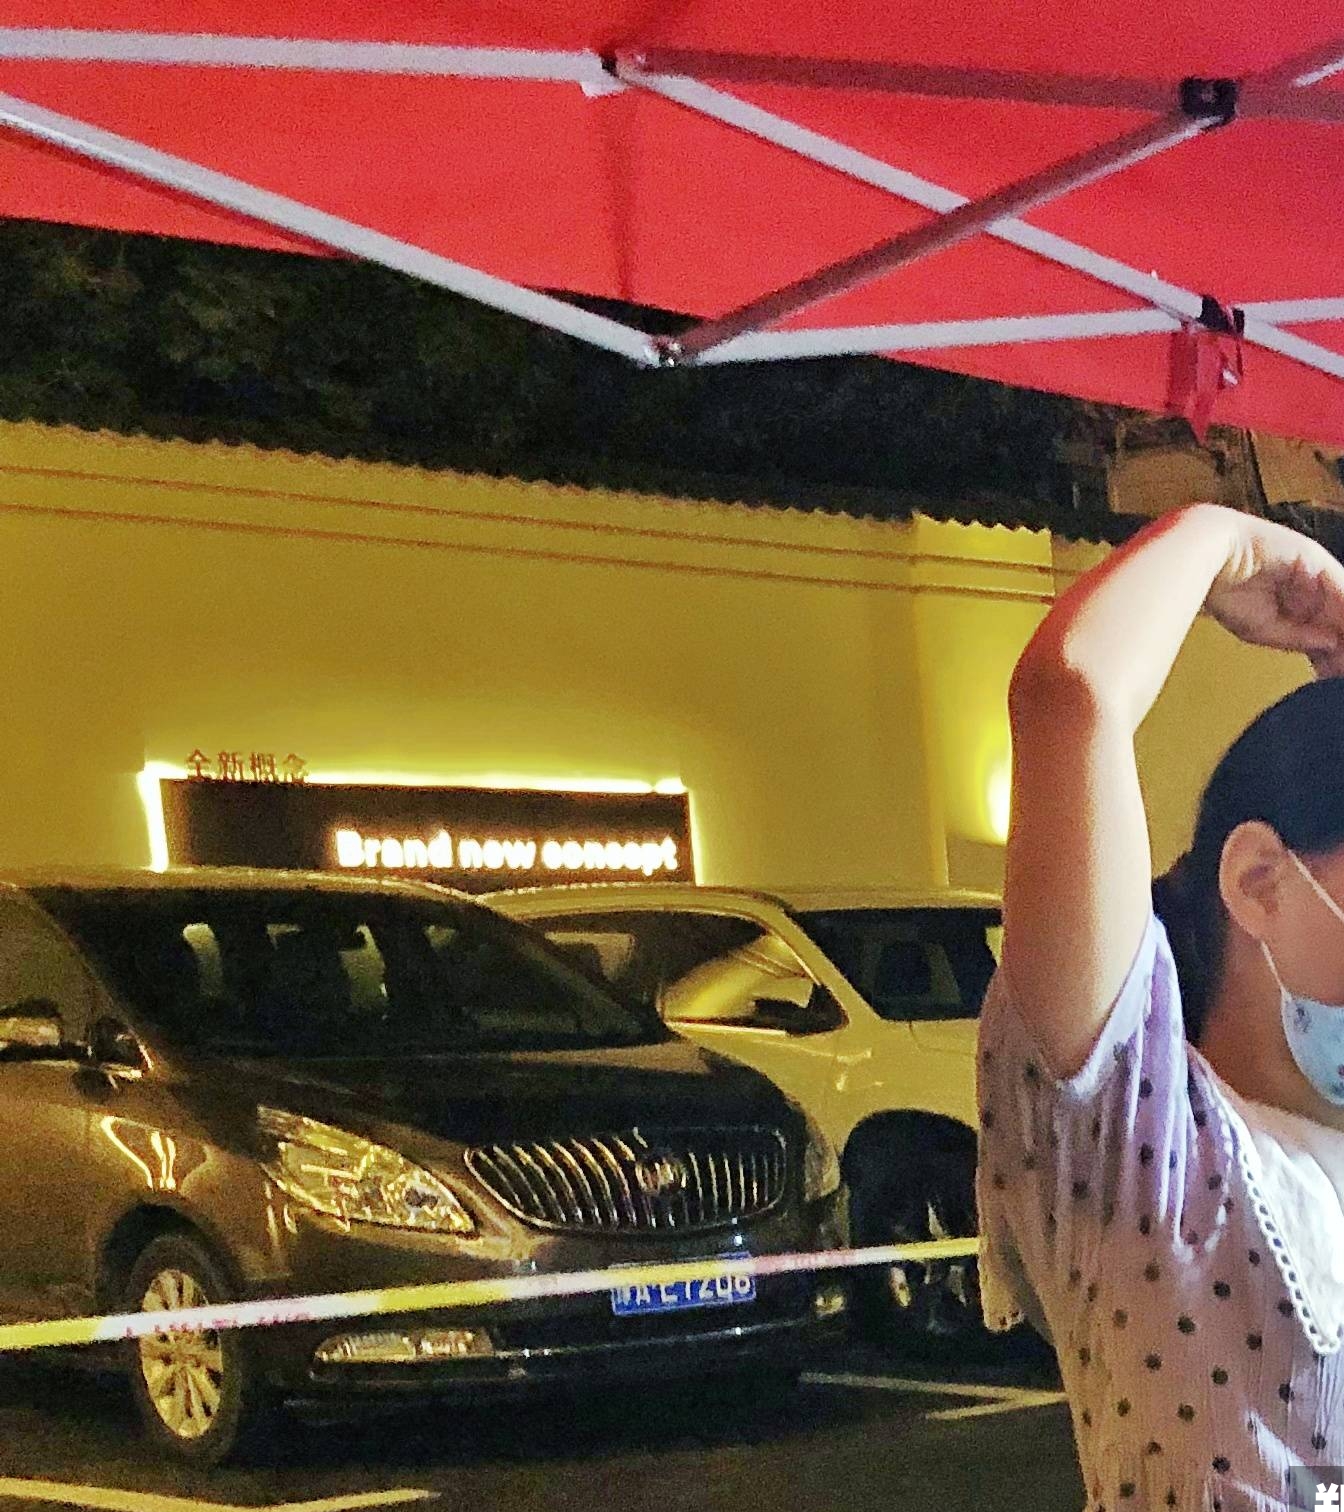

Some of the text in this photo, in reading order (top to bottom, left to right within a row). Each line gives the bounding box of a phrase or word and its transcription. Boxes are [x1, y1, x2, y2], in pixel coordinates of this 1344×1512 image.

[336, 829, 677, 876] Brand new concept
